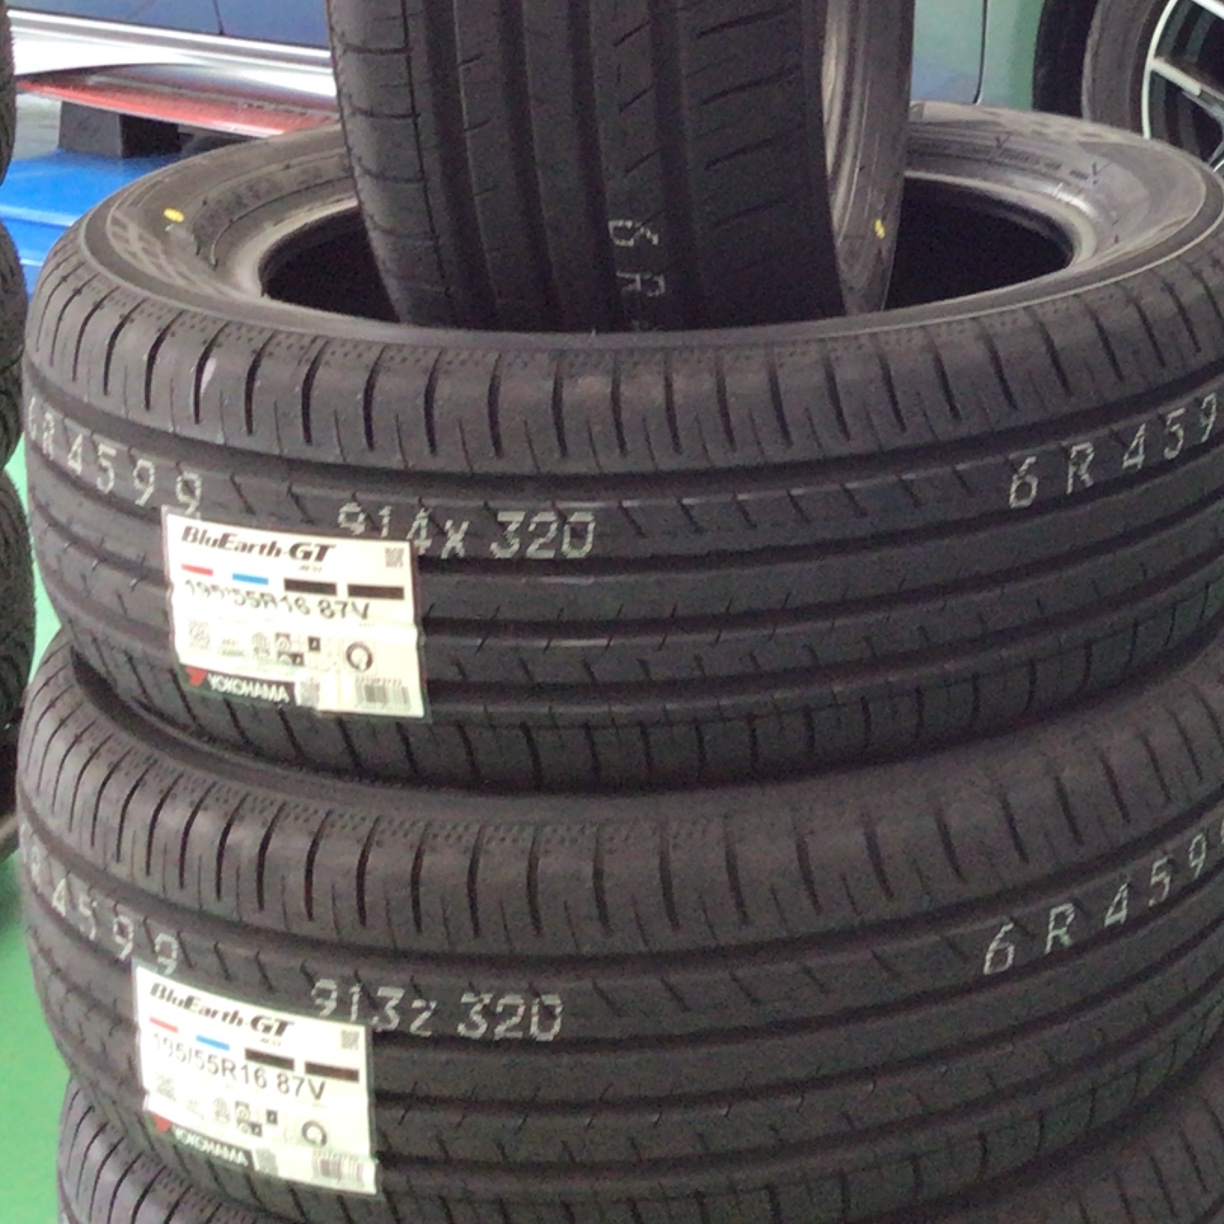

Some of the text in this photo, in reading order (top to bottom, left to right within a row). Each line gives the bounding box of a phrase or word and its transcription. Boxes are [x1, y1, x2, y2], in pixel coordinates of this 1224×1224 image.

[490, 510, 596, 560] 320
[457, 992, 564, 1042] 320
[277, 1072, 326, 1101] 87V
